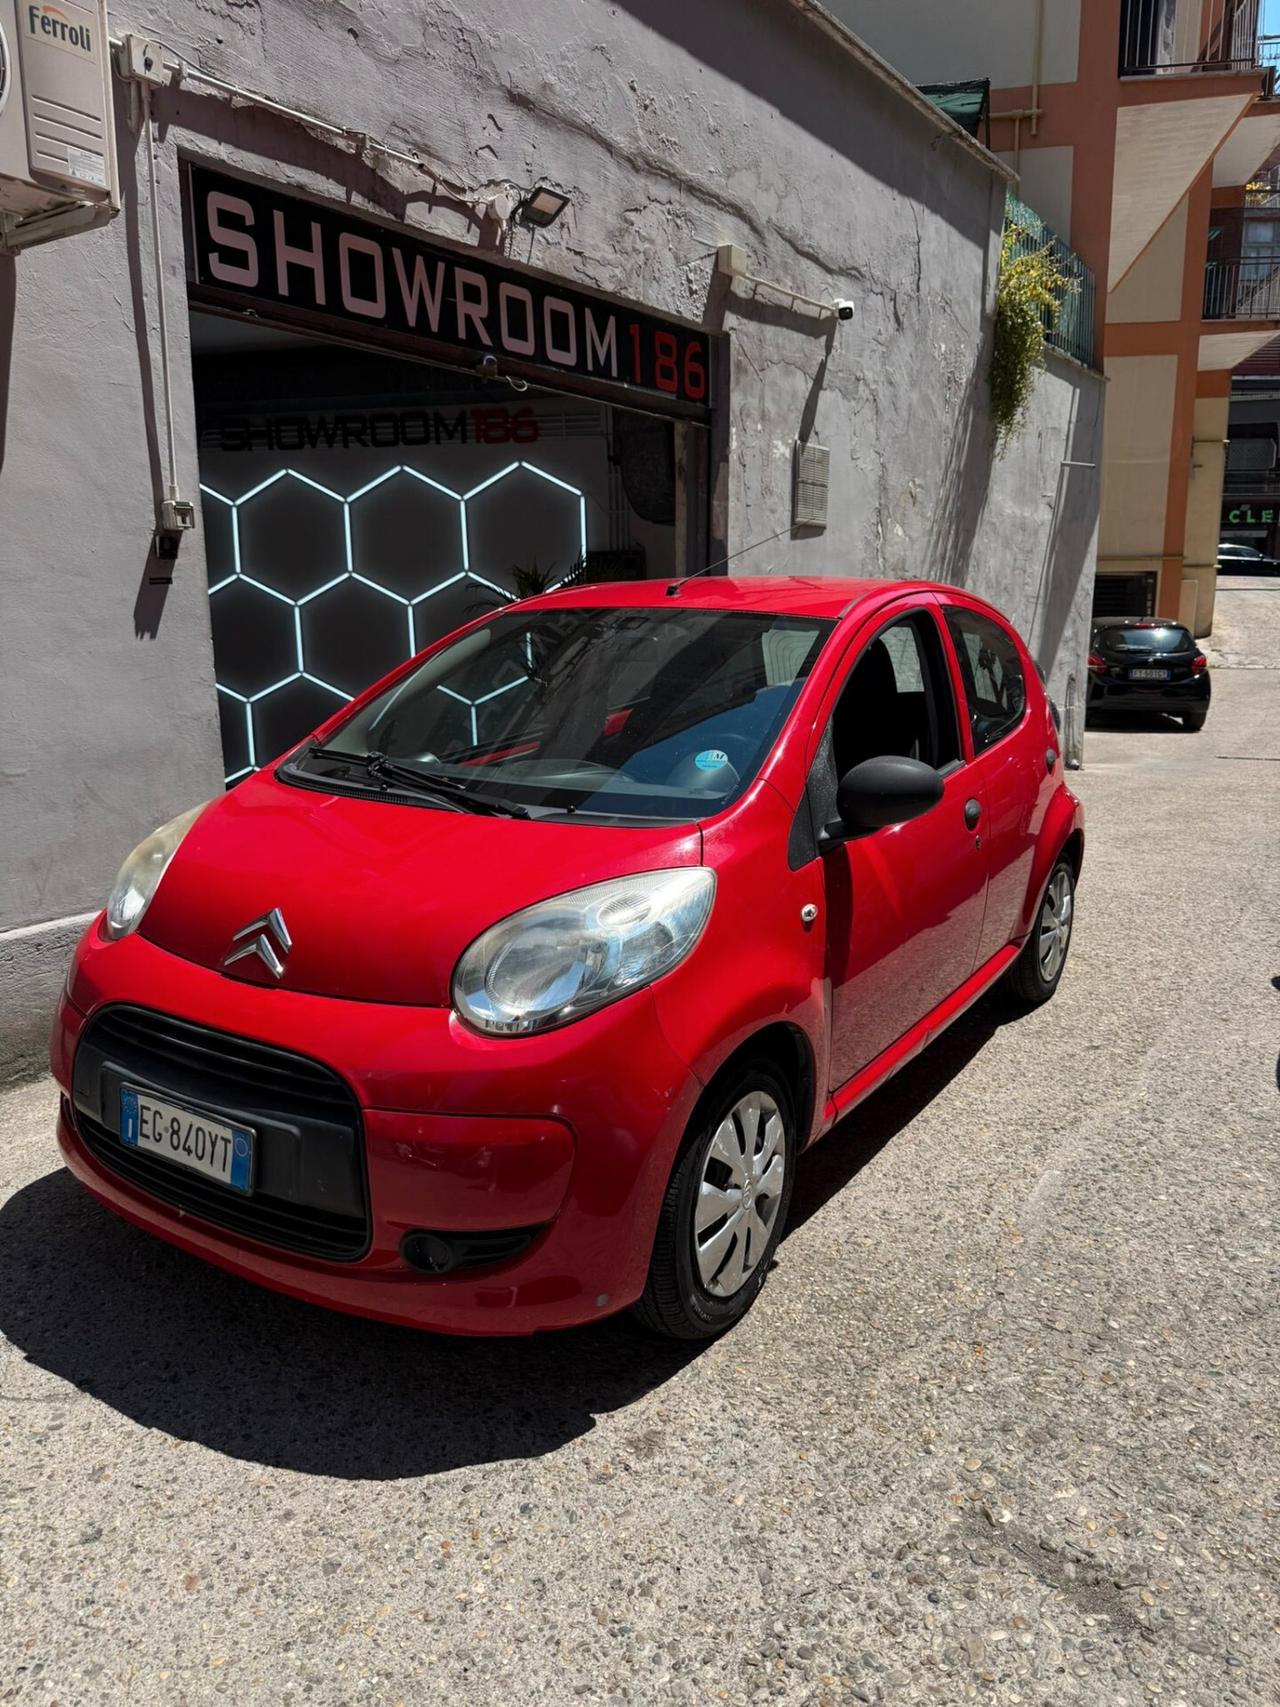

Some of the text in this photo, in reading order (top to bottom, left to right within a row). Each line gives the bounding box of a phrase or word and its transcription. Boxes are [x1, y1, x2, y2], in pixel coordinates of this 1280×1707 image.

[28, 4, 92, 52] Ferroli
[206, 190, 618, 378] SHOWROOM
[1229, 510, 1280, 524] CLE
